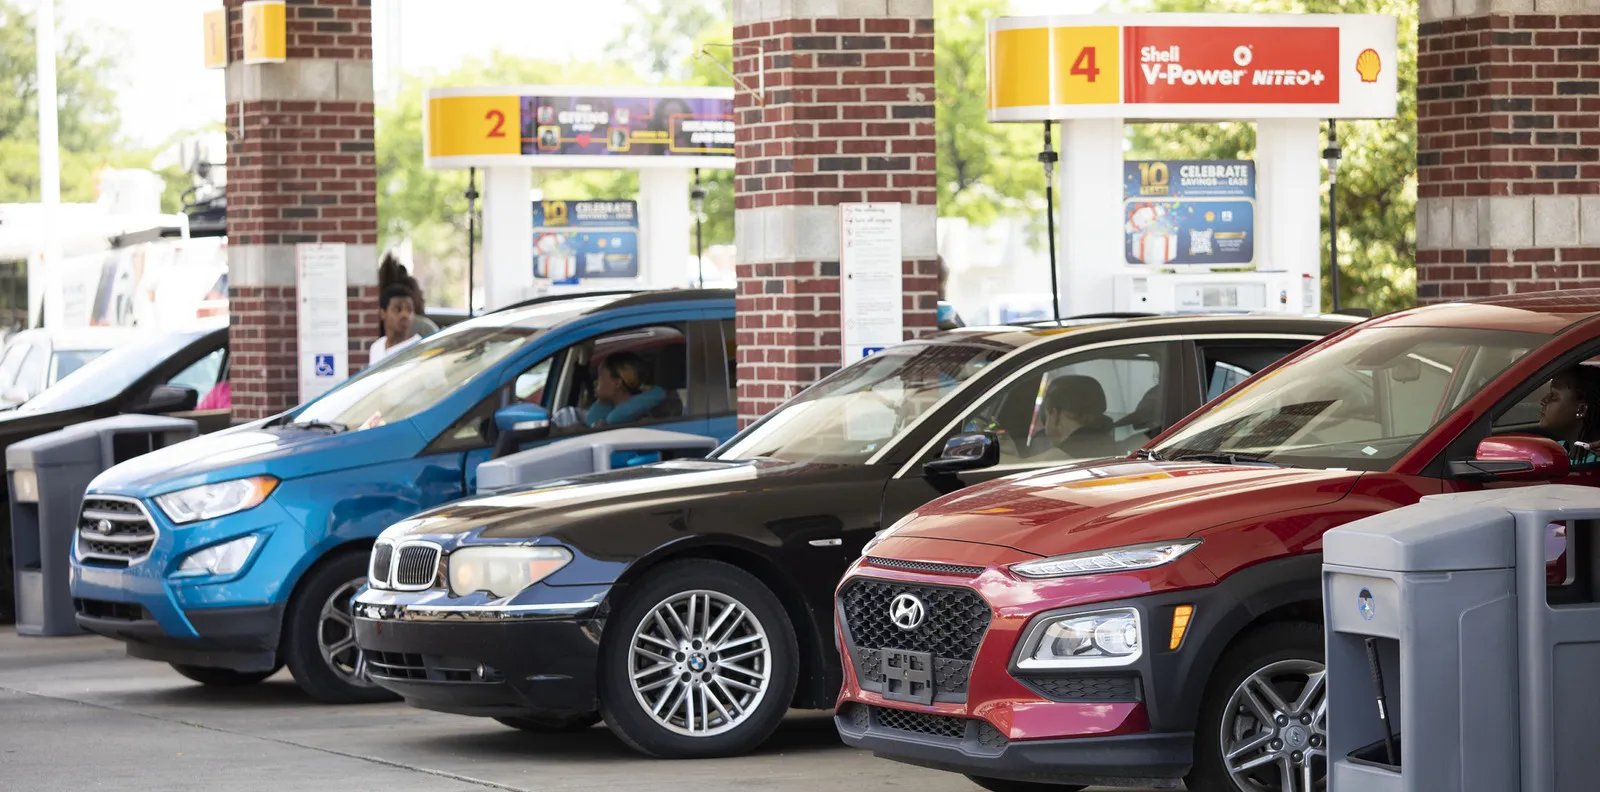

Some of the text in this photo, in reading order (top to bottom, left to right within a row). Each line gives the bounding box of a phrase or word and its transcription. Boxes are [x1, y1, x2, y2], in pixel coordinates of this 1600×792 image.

[1070, 46, 1100, 83] 4
[1140, 45, 1180, 63] Shell
[1140, 63, 1245, 86] V-Power
[485, 110, 506, 138] 2
[1138, 162, 1169, 186] 10
[1180, 165, 1248, 178] CELEBRATE
[1181, 177, 1217, 186] SAVINGS
[1228, 177, 1248, 186] EASE
